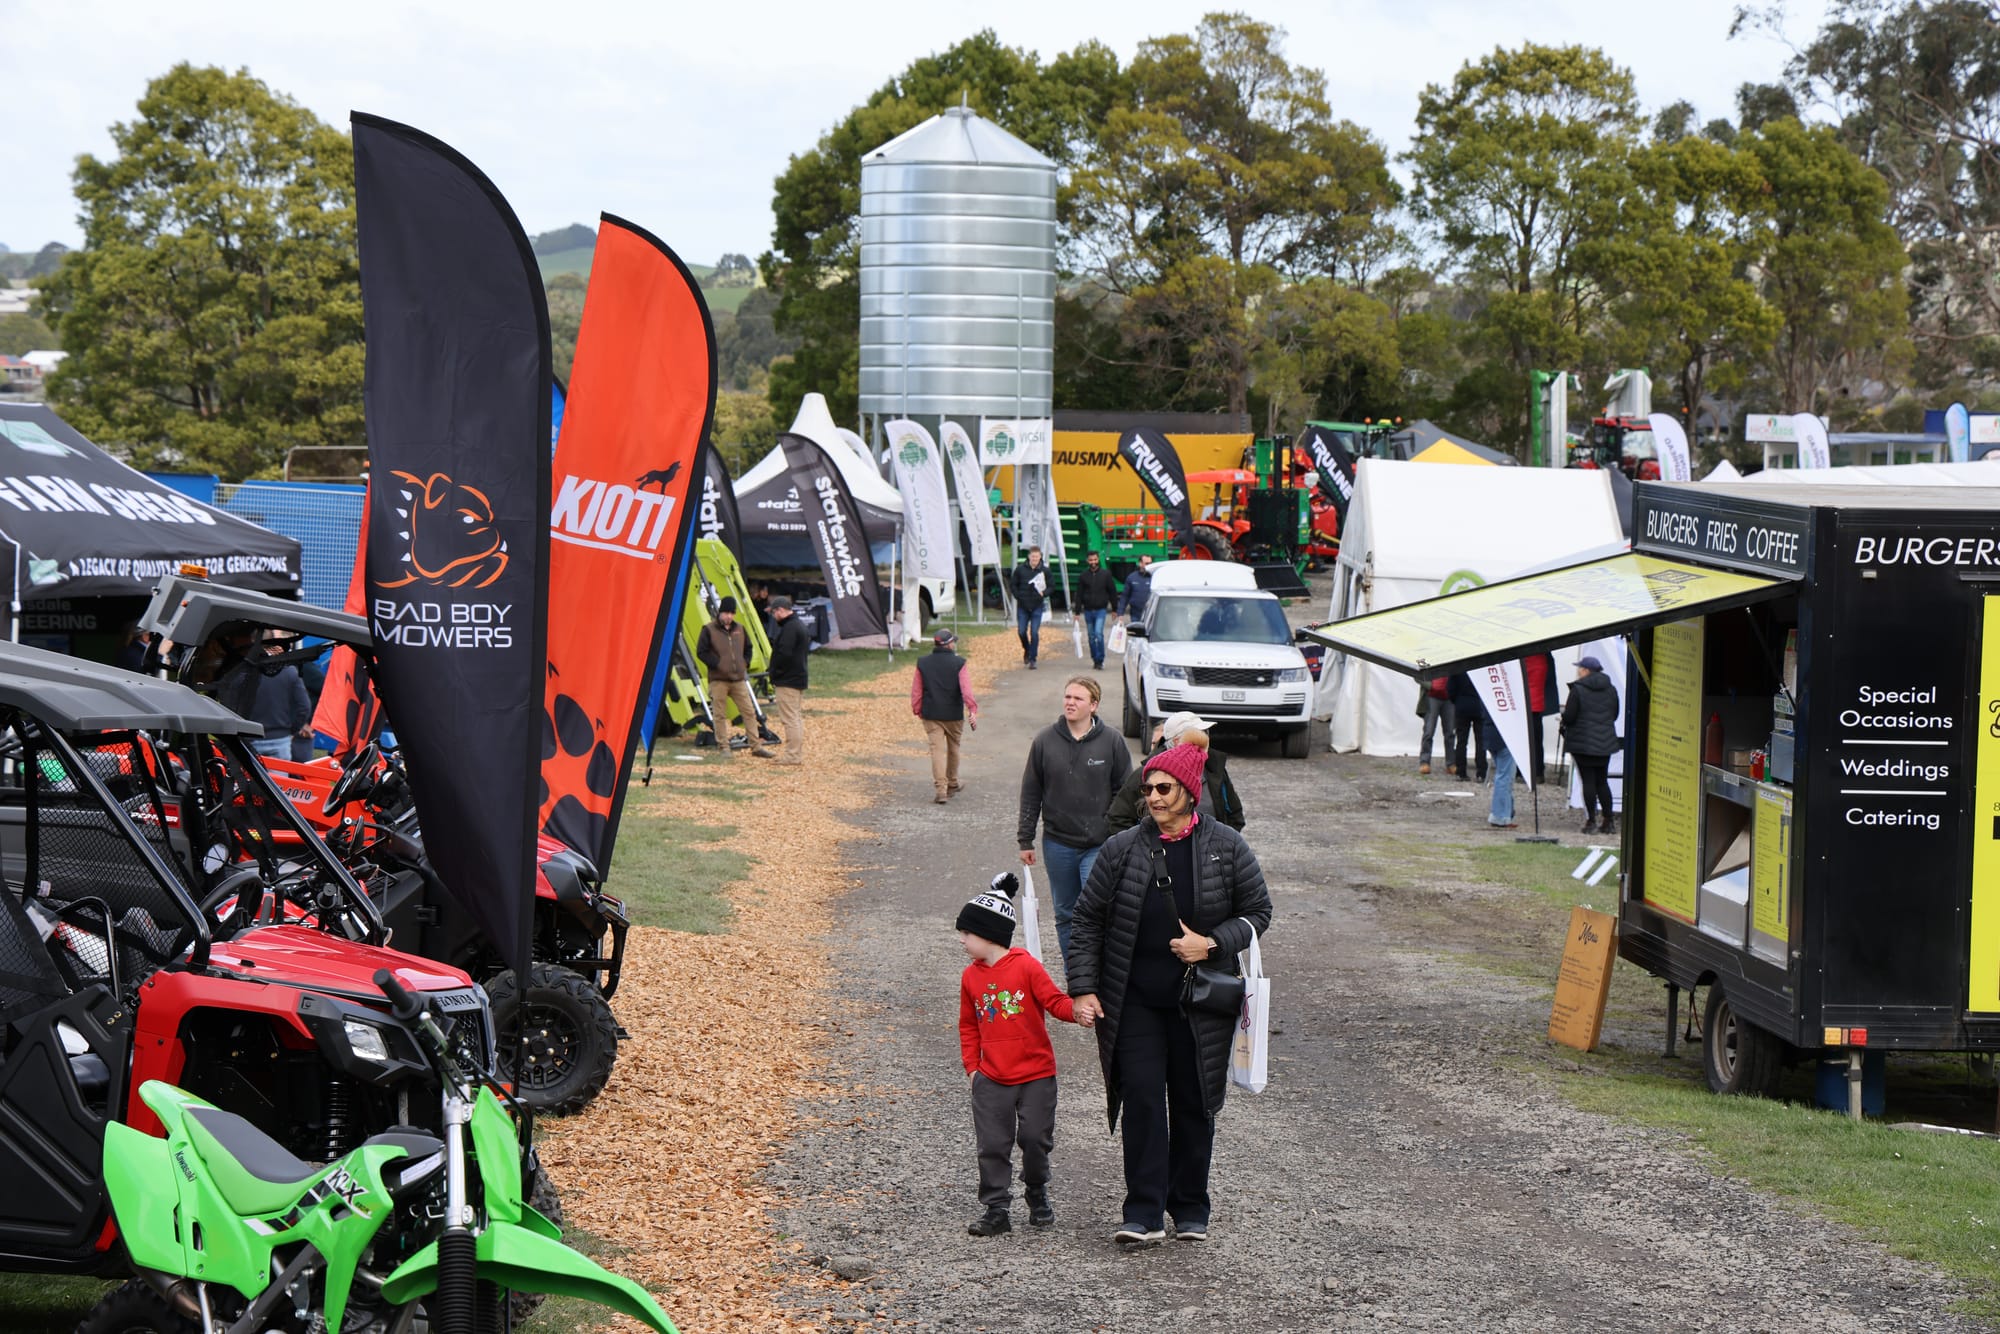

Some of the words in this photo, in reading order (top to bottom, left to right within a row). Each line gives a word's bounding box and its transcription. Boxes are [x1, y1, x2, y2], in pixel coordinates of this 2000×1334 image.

[1057, 451, 1121, 471] AUSMIX
[1129, 433, 1185, 507] TRULINE
[1312, 433, 1353, 500] TRULINE
[89, 483, 216, 525] SHEDS
[550, 474, 677, 550] KIOTI
[815, 475, 865, 597] statewide
[1647, 509, 1699, 546] BURGERS
[1705, 520, 1738, 554] FRIES
[1746, 526, 1799, 564] COFFEE
[80, 558, 117, 577] LEGACY
[118, 559, 131, 576] OF
[825, 559, 846, 600] products
[374, 598, 441, 623] BAD
[451, 604, 513, 624] BOY
[374, 619, 513, 648] MOWERS
[1858, 685, 1937, 707] Special
[1839, 710, 1953, 729] Occasions
[1840, 758, 1949, 782] Weddings
[1845, 808, 1940, 831] Catering
[174, 1151, 197, 1183] Kawasaki
